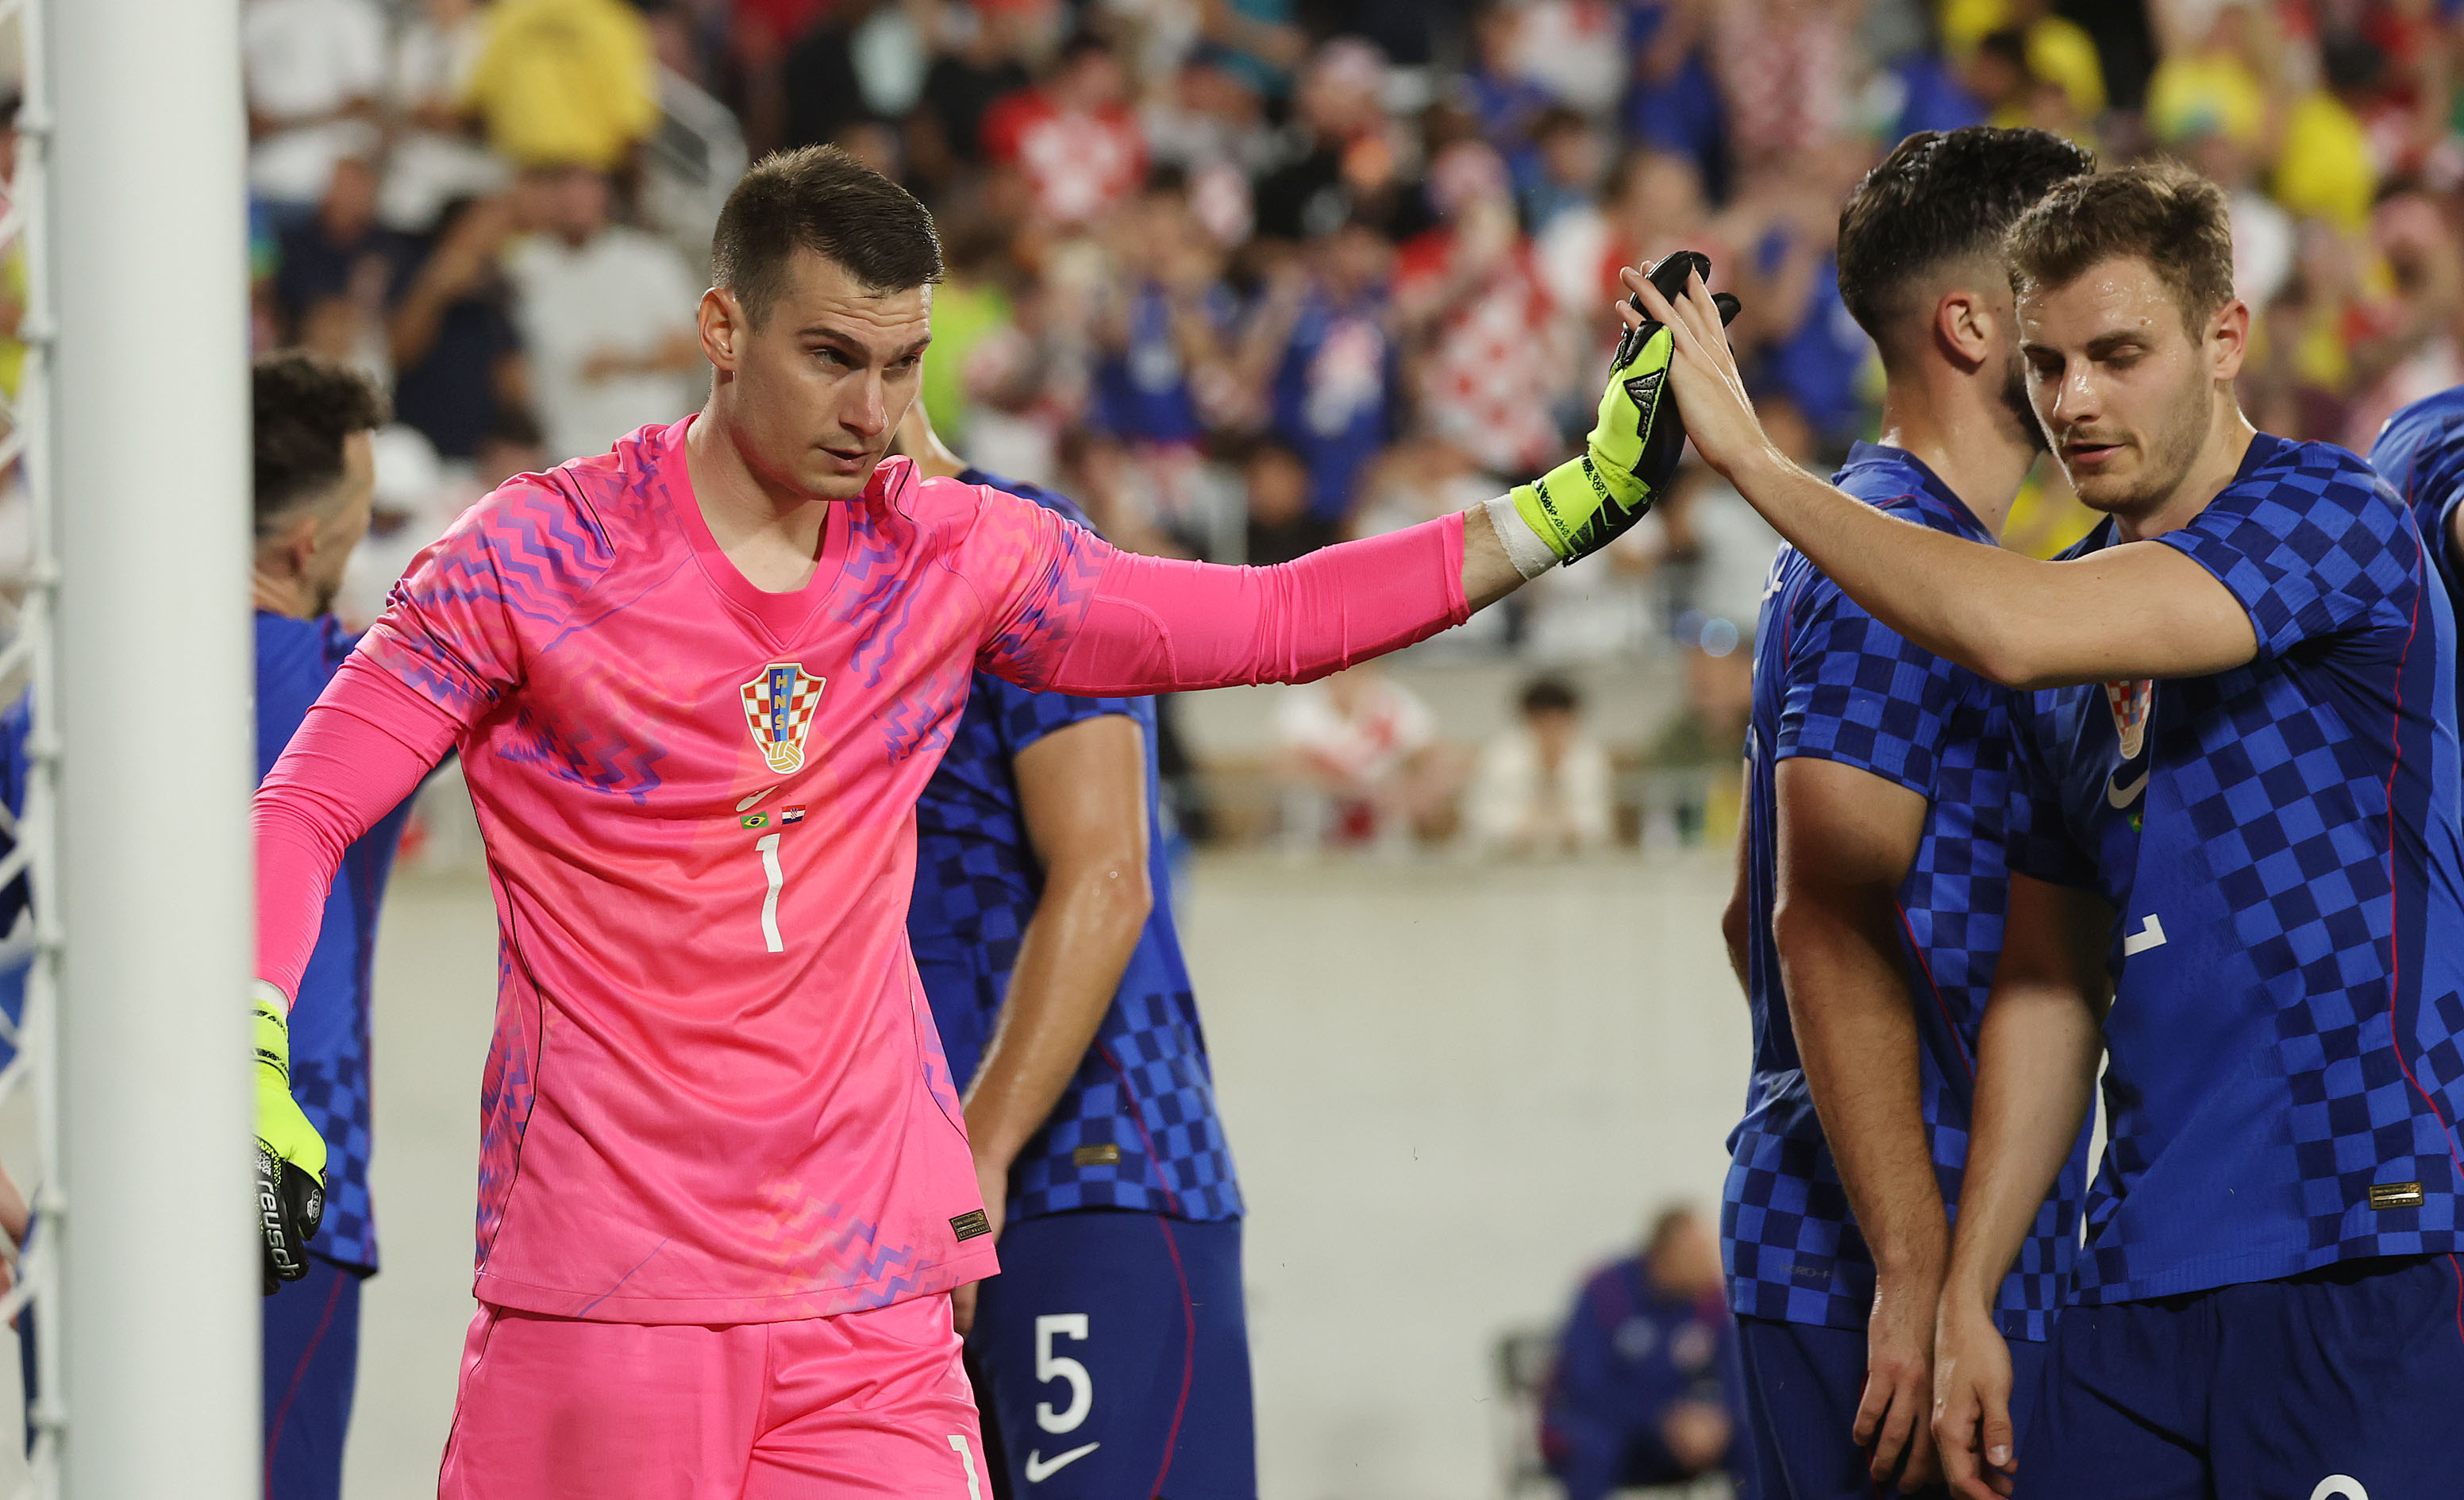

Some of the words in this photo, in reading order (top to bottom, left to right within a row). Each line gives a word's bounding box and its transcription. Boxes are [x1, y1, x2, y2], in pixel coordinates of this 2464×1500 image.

[774, 674, 789, 731] HNS
[755, 833, 784, 953] 1
[256, 1180, 300, 1278] reusch
[1035, 1313, 1093, 1434] 5
